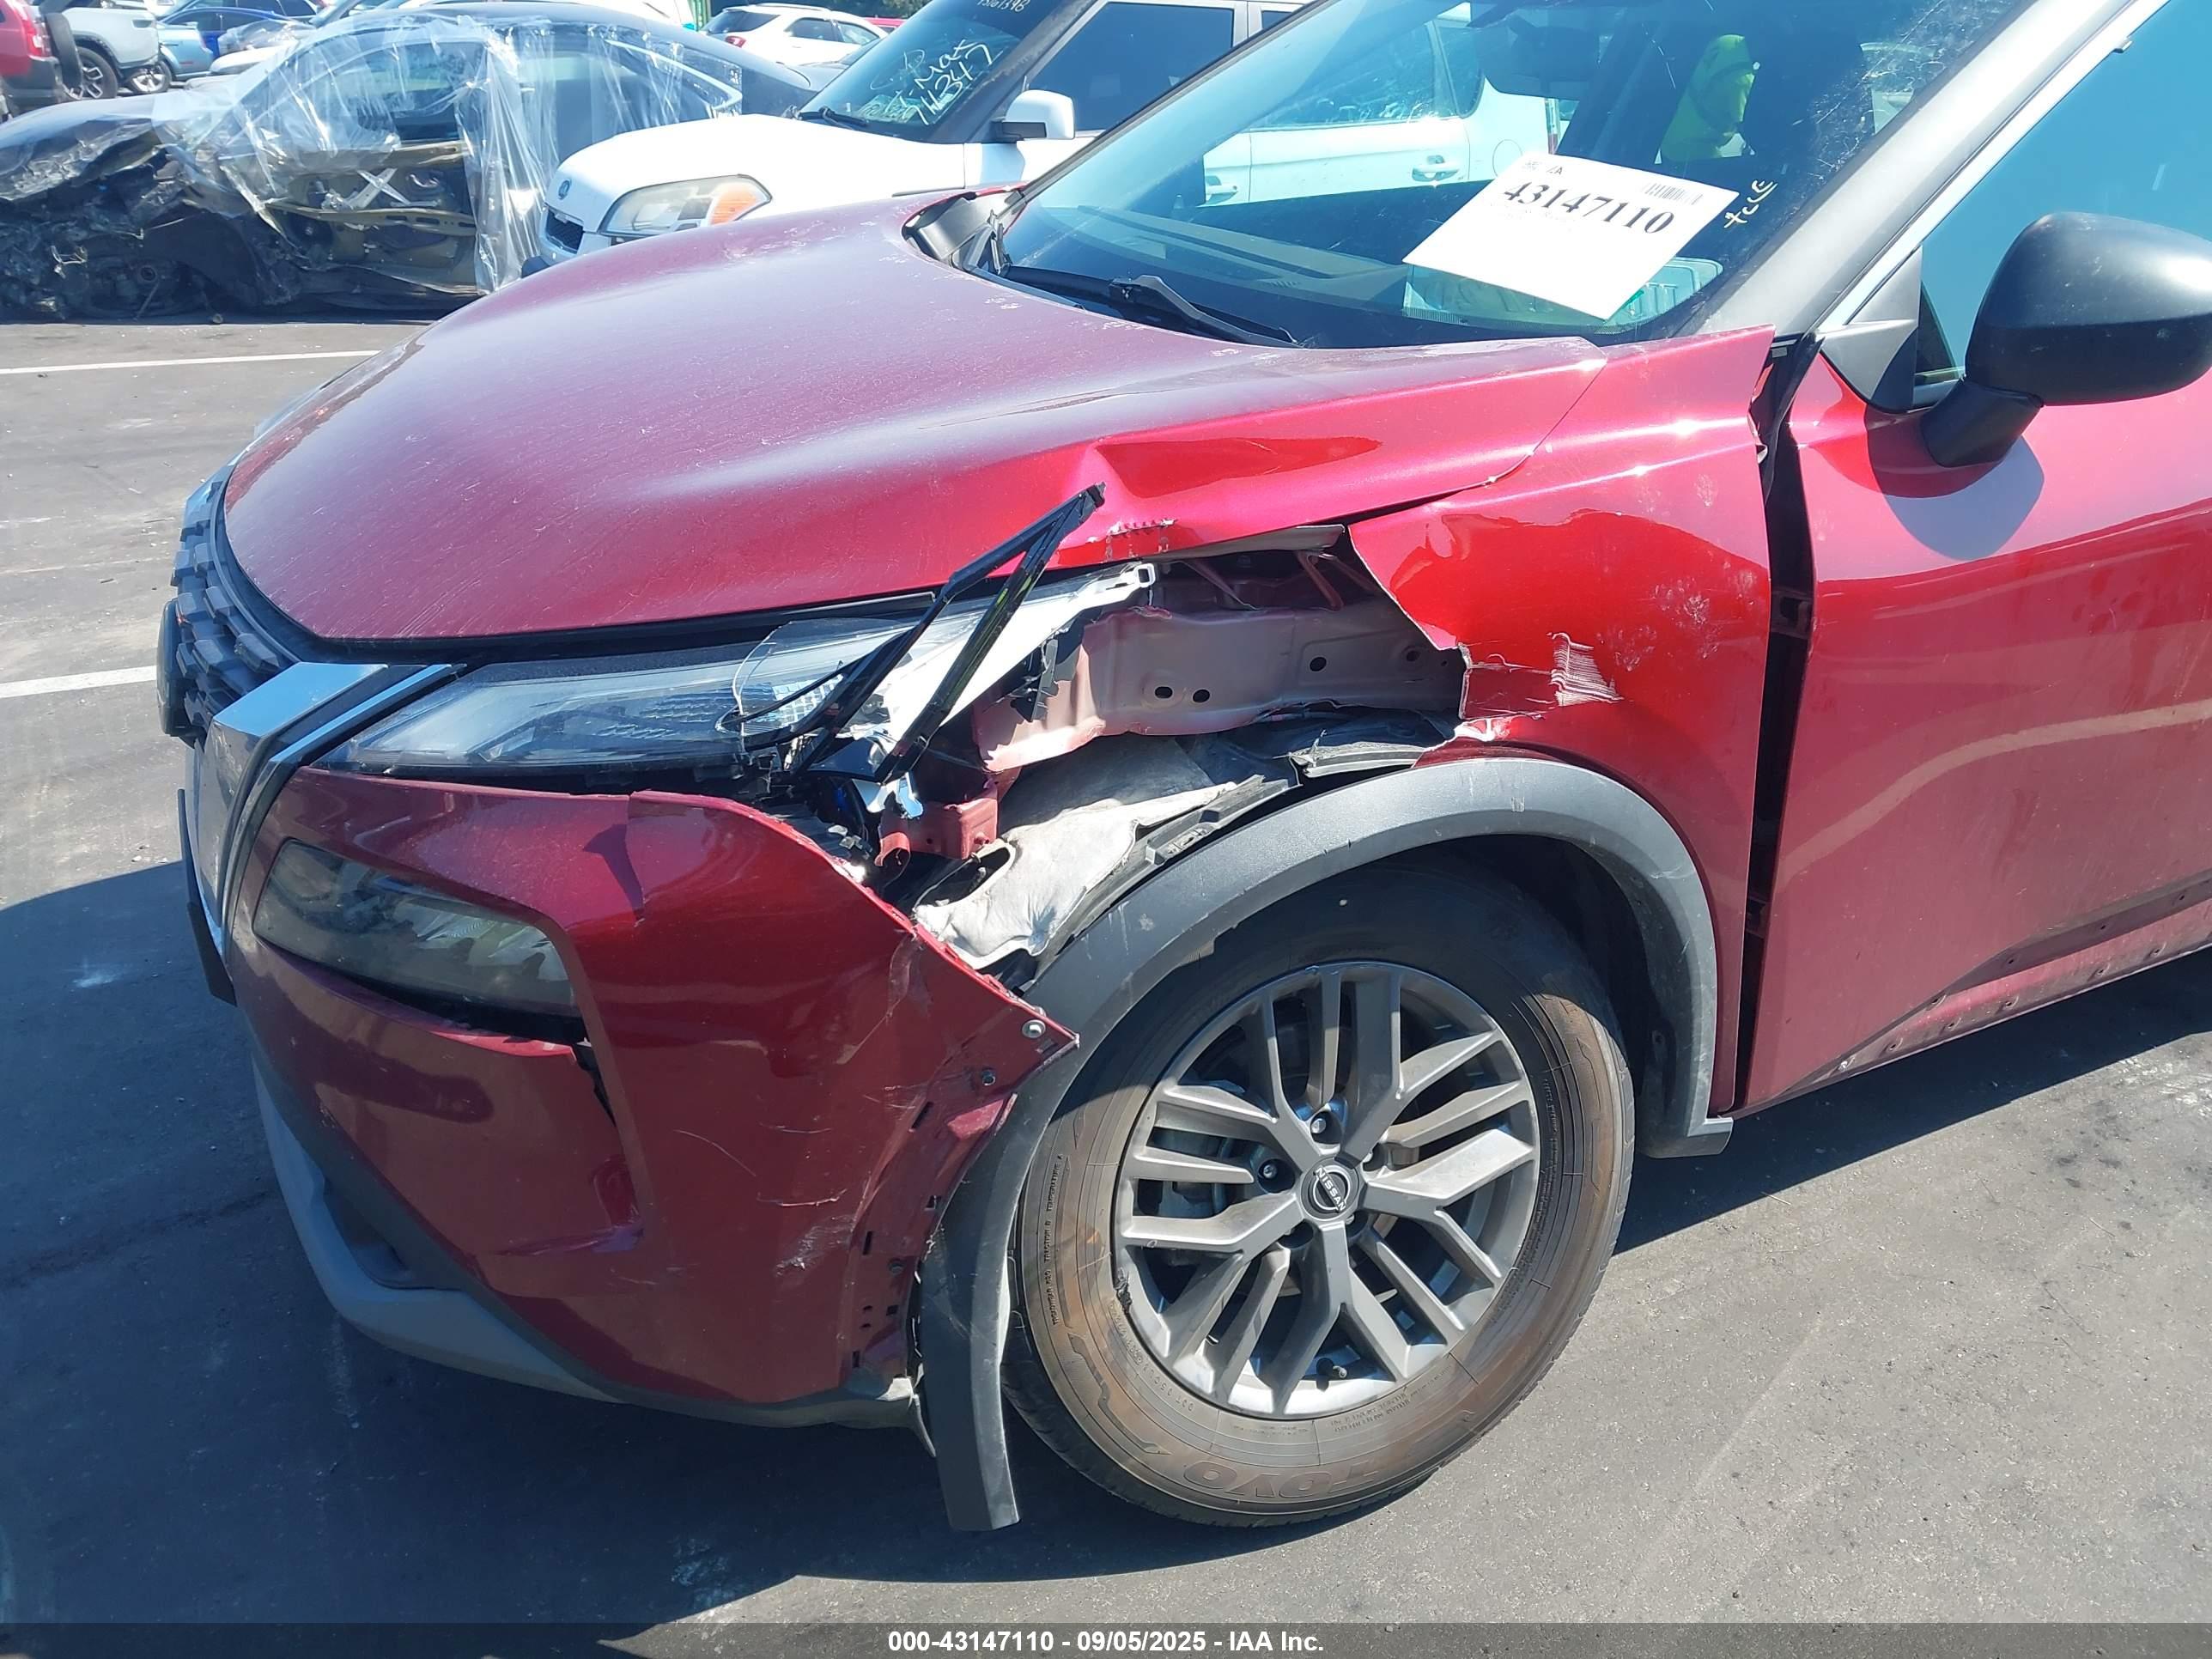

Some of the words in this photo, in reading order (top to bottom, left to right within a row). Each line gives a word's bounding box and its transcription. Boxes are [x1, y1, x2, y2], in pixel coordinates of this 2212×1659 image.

[1504, 181, 1674, 234] 43147110
[1316, 1165, 1346, 1211] NISSAN
[1183, 1460, 1380, 1498] TOYO
